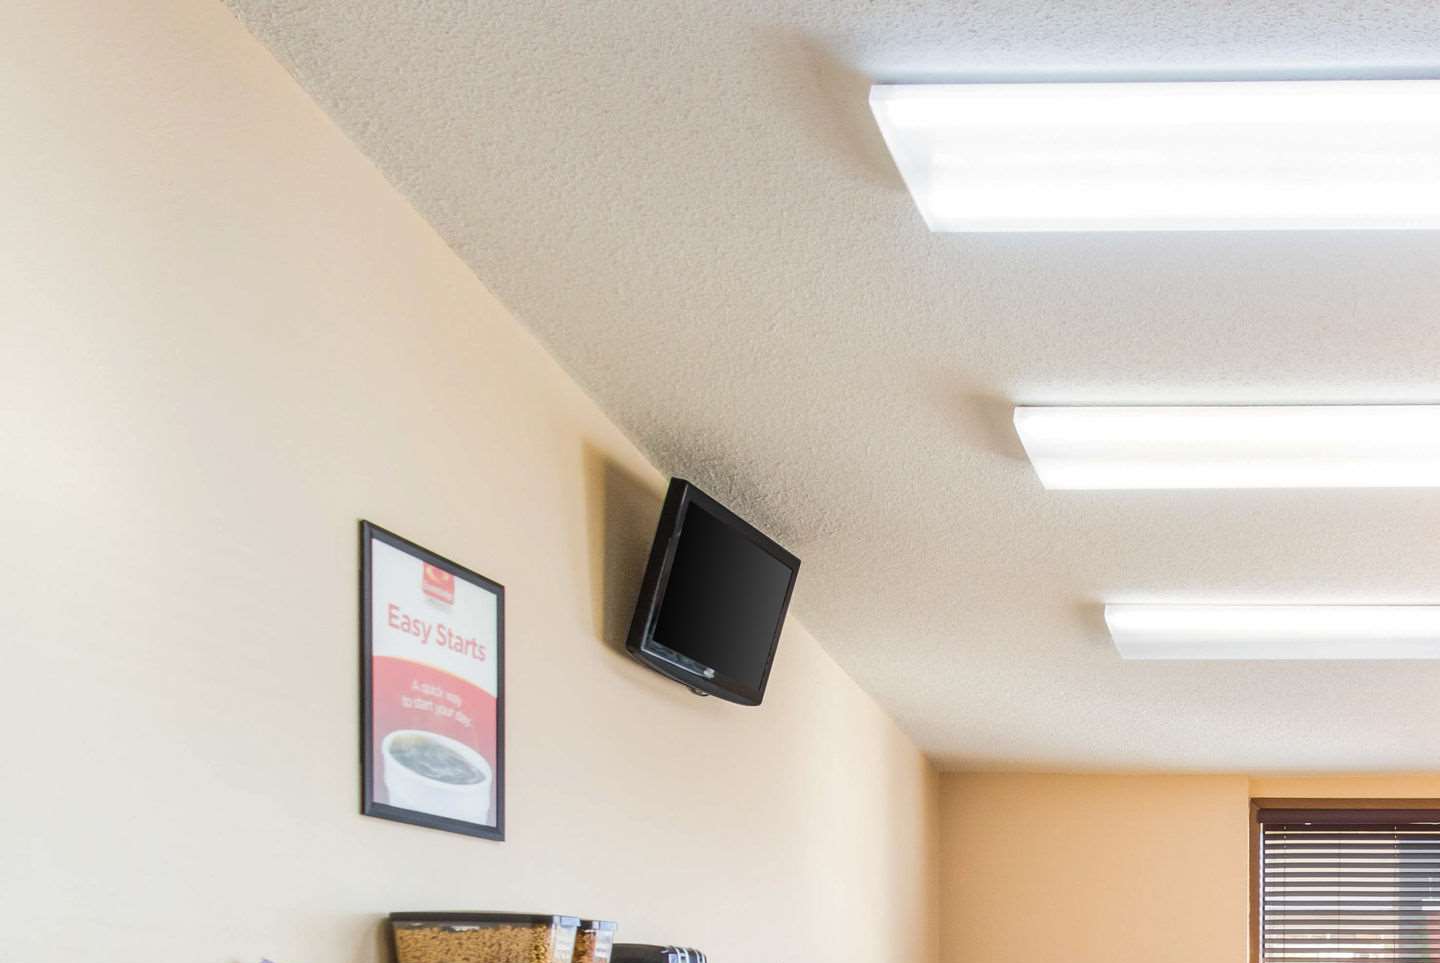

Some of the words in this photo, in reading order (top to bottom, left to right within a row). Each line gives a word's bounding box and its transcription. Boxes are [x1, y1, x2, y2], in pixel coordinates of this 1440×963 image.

[388, 603, 432, 645] Easy
[436, 622, 487, 661] Starts
[401, 696, 413, 708] to
[414, 697, 433, 712] start
[435, 704, 455, 719] your
